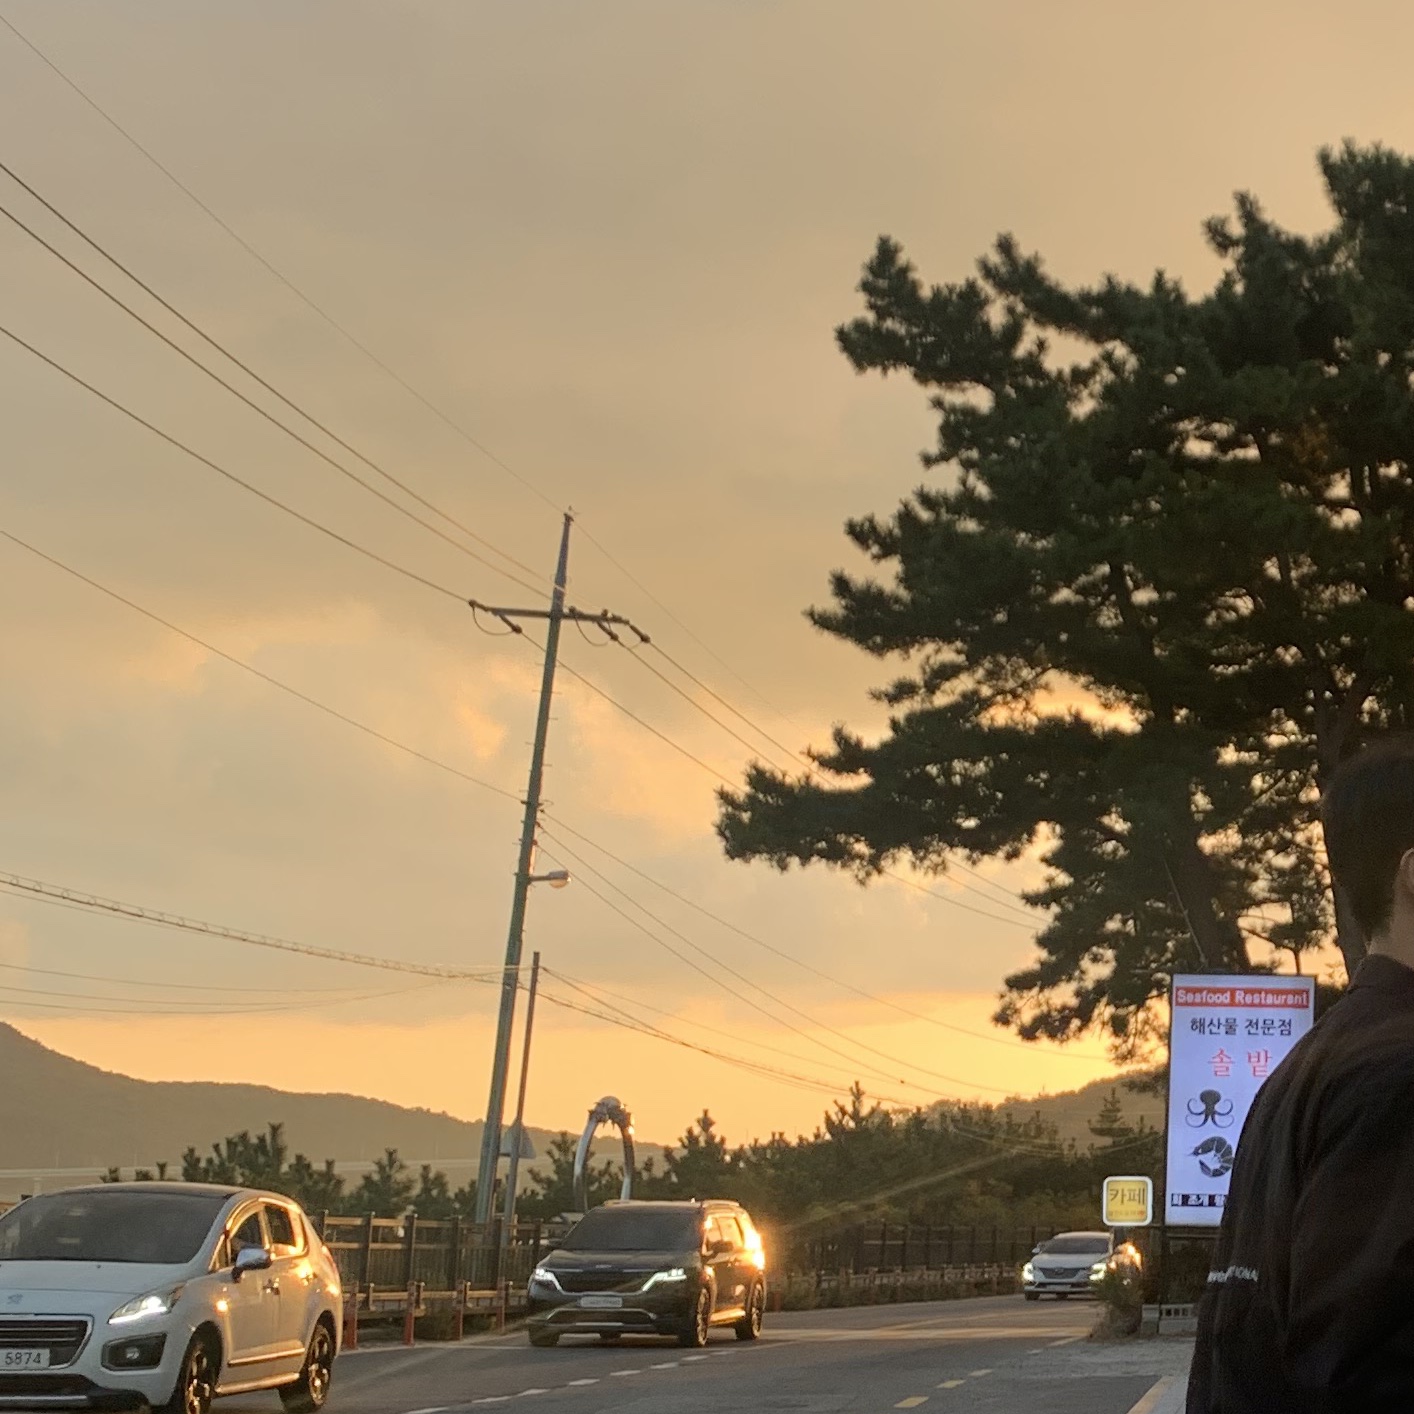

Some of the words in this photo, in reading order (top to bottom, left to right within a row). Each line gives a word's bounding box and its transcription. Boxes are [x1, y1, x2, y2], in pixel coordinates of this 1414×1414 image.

[1177, 988, 1230, 1004] Seafood
[1235, 989, 1308, 1006] Restaurant
[1190, 1017, 1238, 1036] 해산물
[1244, 1018, 1292, 1037] 전문점
[1109, 1187, 1146, 1206] 카페
[5, 1351, 42, 1365] 5874
